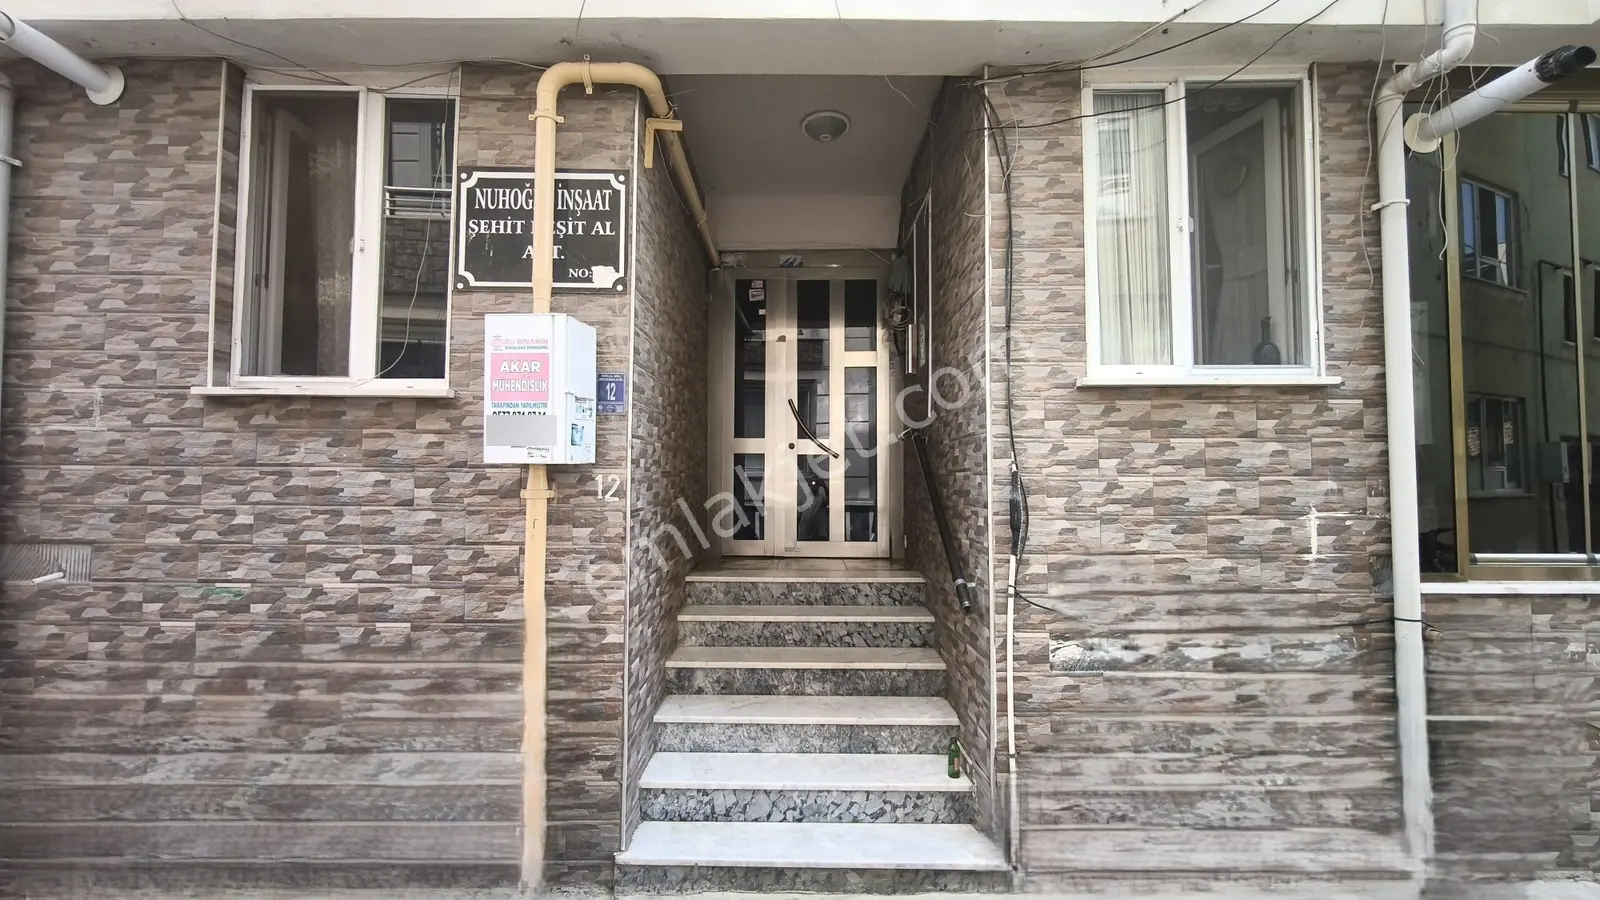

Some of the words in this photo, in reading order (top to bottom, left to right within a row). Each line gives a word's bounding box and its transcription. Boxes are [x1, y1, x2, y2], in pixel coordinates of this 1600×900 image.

[475, 182, 535, 209] NUHOĞ
[557, 183, 612, 216] İNŞAAT
[468, 216, 525, 238] ŞEHİT
[530, 217, 586, 238] ŞİT
[591, 221, 615, 235] AL
[521, 245, 564, 259] AT.
[500, 360, 541, 373] AKAR
[605, 382, 616, 401] 12
[594, 474, 621, 502] 12
